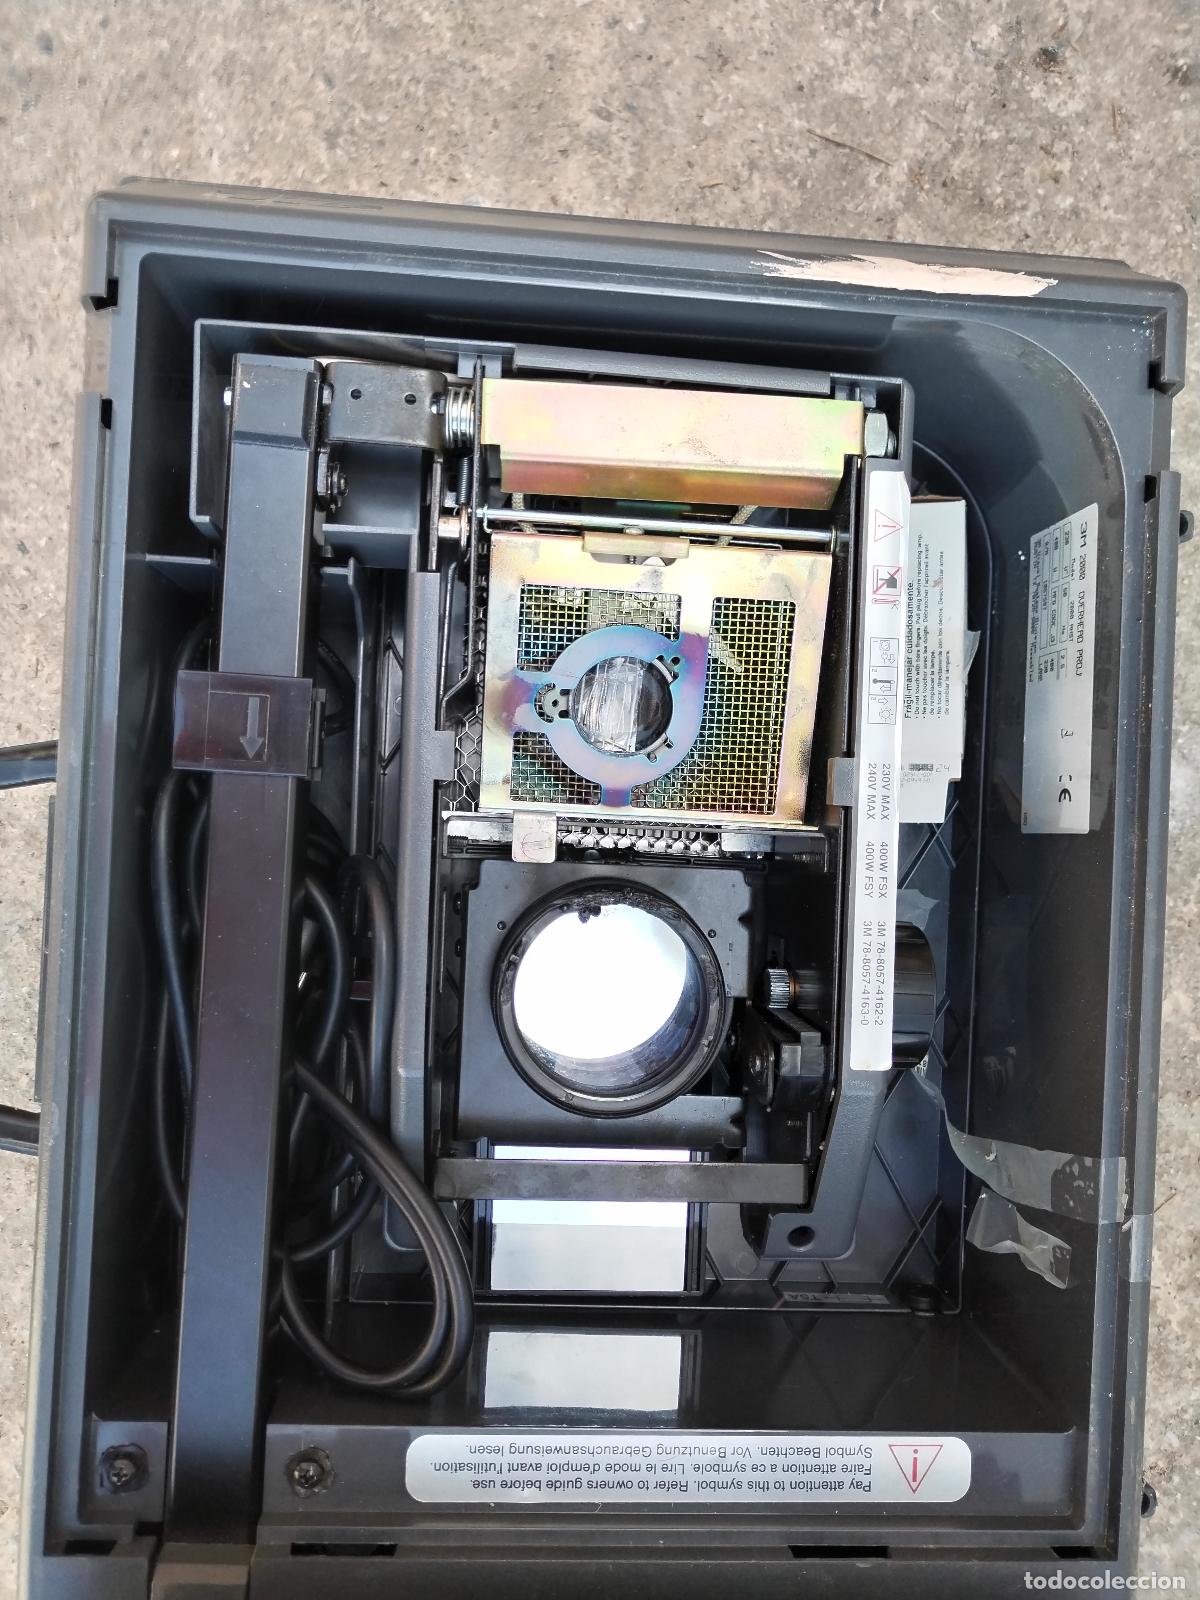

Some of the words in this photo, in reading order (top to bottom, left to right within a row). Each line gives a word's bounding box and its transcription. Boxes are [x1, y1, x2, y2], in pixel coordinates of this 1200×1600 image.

[1080, 521, 1087, 548] 3M
[905, 580, 914, 654] cuidadosamente.
[867, 763, 877, 790] 240V
[881, 763, 891, 791] 230V
[866, 794, 876, 820] MAX
[880, 795, 890, 821] MAX
[865, 841, 874, 872] 400W
[879, 841, 888, 872] 400W
[864, 876, 874, 898] FSY
[878, 876, 888, 898] FSX
[863, 921, 872, 937] 3M
[877, 921, 886, 937] 3M
[860, 941, 872, 1026] 78-8057-4163-0
[874, 941, 886, 1026] 78-8057-4162-2
[465, 1445, 504, 1456] lesen.
[509, 1443, 652, 1457] Gebrauchsanweisung
[657, 1444, 727, 1458] Benutzung
[730, 1446, 752, 1458] Vor
[757, 1446, 820, 1458] Beachten.
[825, 1444, 873, 1458] Symbol
[430, 1462, 503, 1474] l'utilisation.
[507, 1462, 542, 1473] avant
[547, 1461, 601, 1474] d'emploi
[605, 1463, 641, 1474] mode
[646, 1463, 656, 1475] le
[661, 1463, 685, 1475] Lire
[690, 1461, 747, 1475] symbole.
[751, 1463, 766, 1472] ce
[770, 1463, 778, 1473] a
[782, 1463, 837, 1475] attention
[841, 1463, 872, 1475] Faire
[470, 1479, 496, 1489] use.
[500, 1479, 542, 1491] before
[546, 1478, 583, 1491] guide
[587, 1480, 633, 1489] owners
[637, 1480, 650, 1490] to
[654, 1480, 689, 1492] Refer
[694, 1478, 743, 1492] symbol.
[747, 1480, 770, 1492] this
[774, 1480, 785, 1491] to
[789, 1480, 845, 1492] attention
[849, 1478, 872, 1492] Pay
